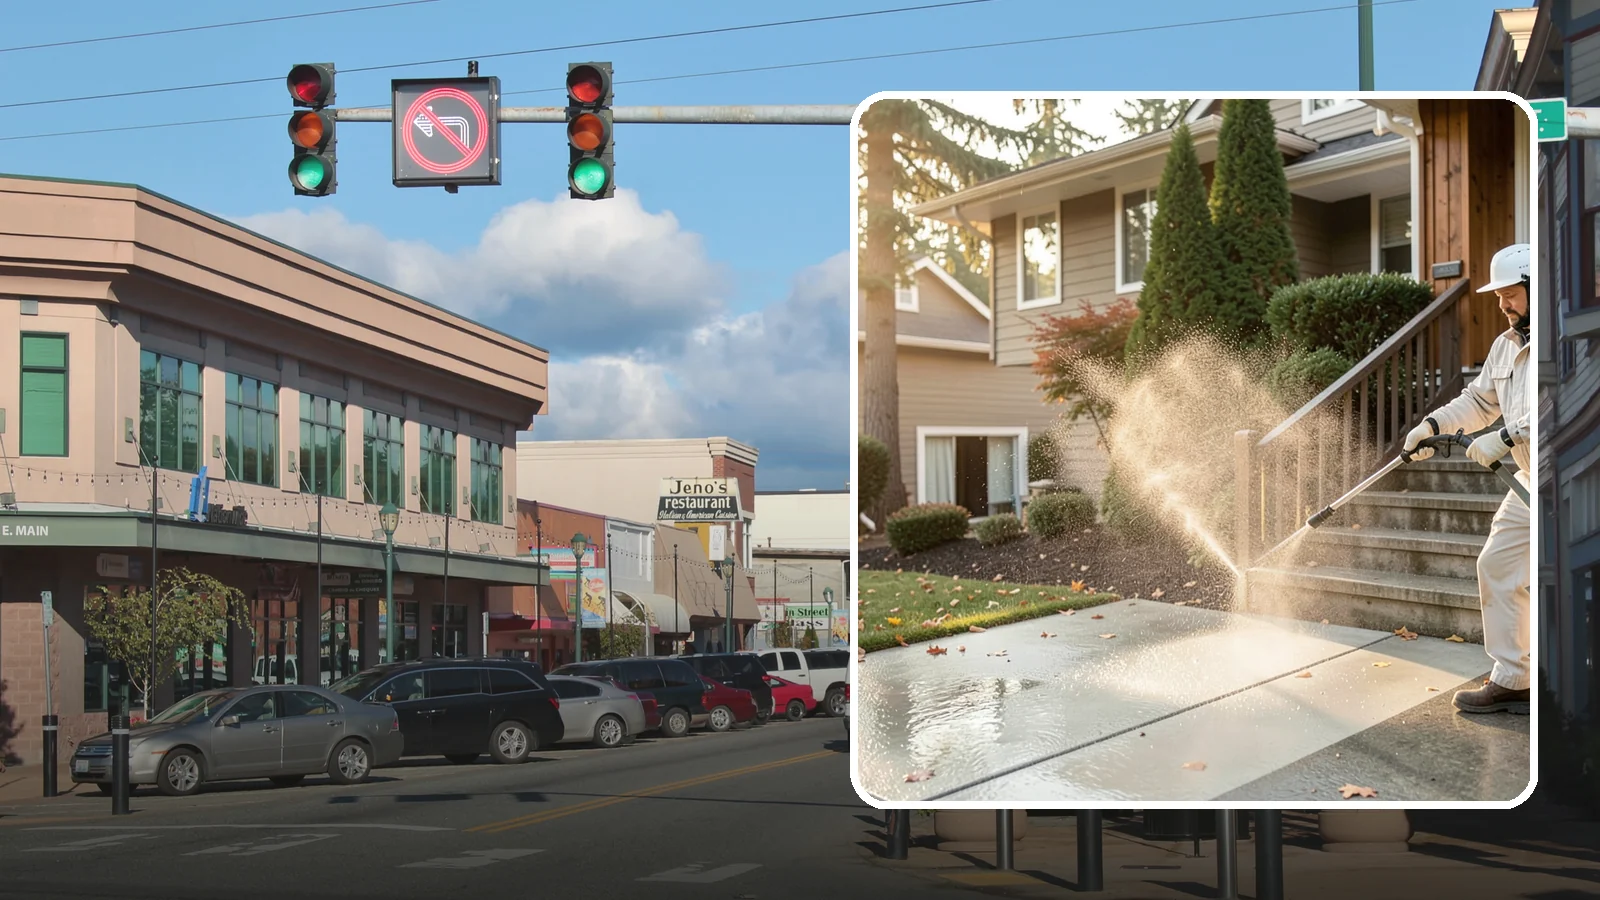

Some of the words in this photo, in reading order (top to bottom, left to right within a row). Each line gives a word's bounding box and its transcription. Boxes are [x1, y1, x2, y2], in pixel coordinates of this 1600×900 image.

[669, 480, 728, 494] Jeno's
[665, 496, 731, 509] restaurant
[658, 510, 682, 520] Italian
[685, 510, 714, 519] American
[714, 509, 737, 519] Cuisine
[2, 525, 13, 536] E.
[15, 525, 49, 536] MAIN
[786, 607, 795, 617] in
[797, 607, 829, 617] Street
[791, 619, 823, 627] lass
